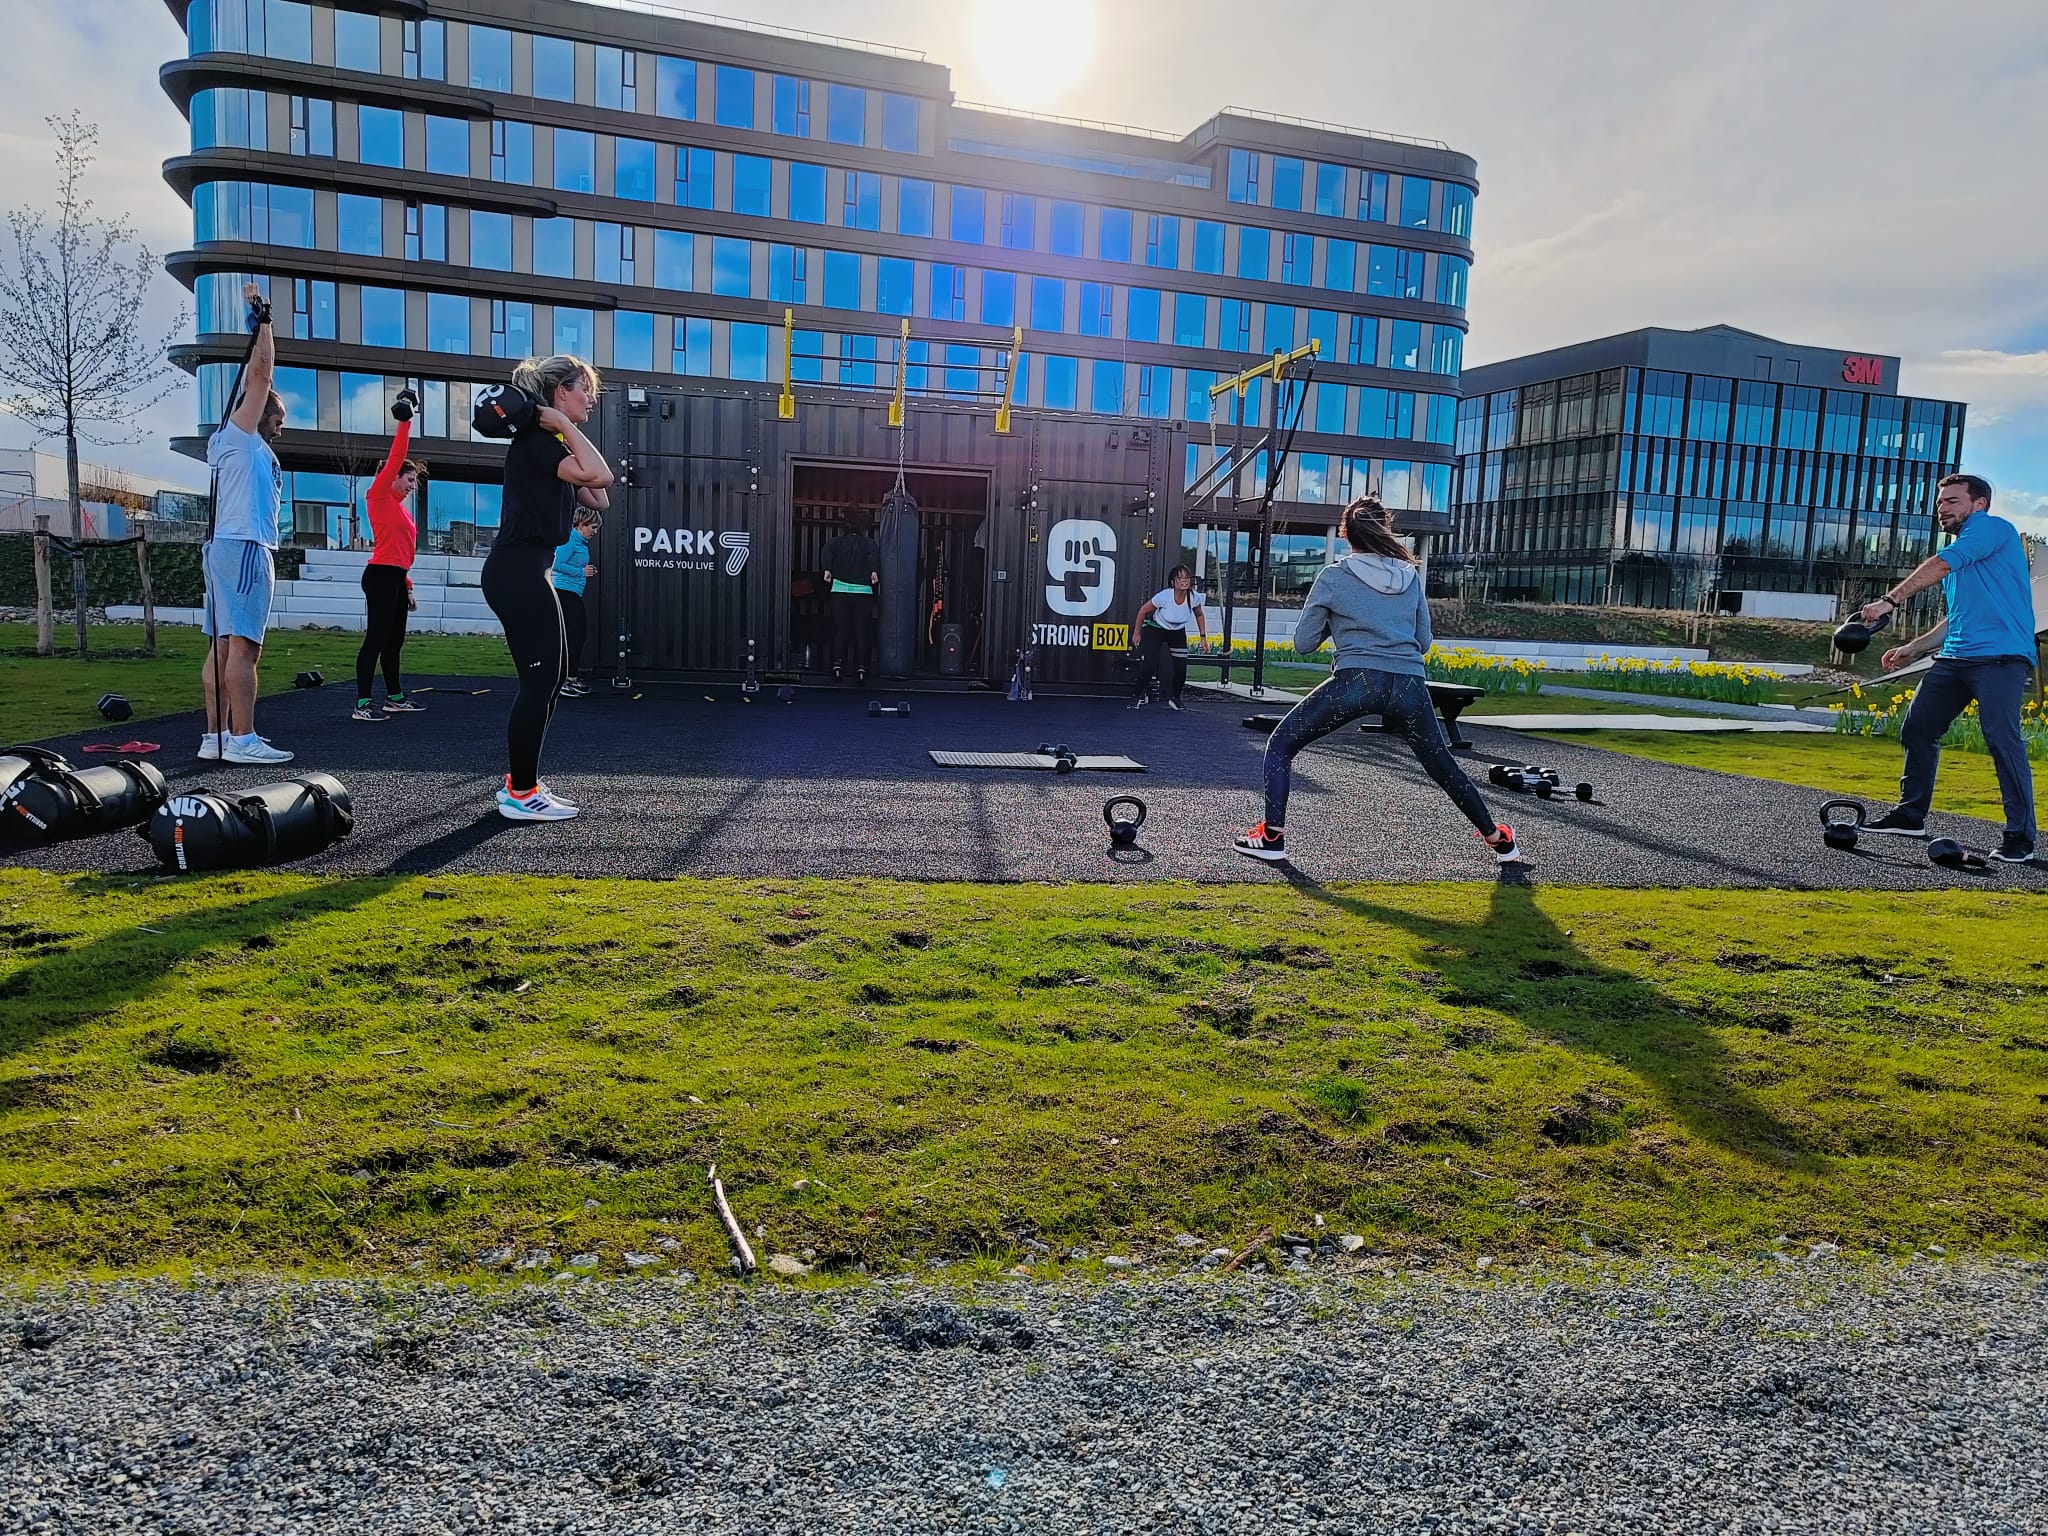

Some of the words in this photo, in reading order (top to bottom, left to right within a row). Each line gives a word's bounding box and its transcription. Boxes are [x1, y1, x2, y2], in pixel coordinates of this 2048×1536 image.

[1843, 356, 1882, 385] 3M
[634, 526, 715, 556] PARK
[719, 531, 750, 576] 7
[634, 558, 660, 568] WORK
[662, 560, 675, 569] AS
[676, 561, 694, 570] YOU
[696, 561, 715, 571] LIVE
[1096, 627, 1125, 647] BOX
